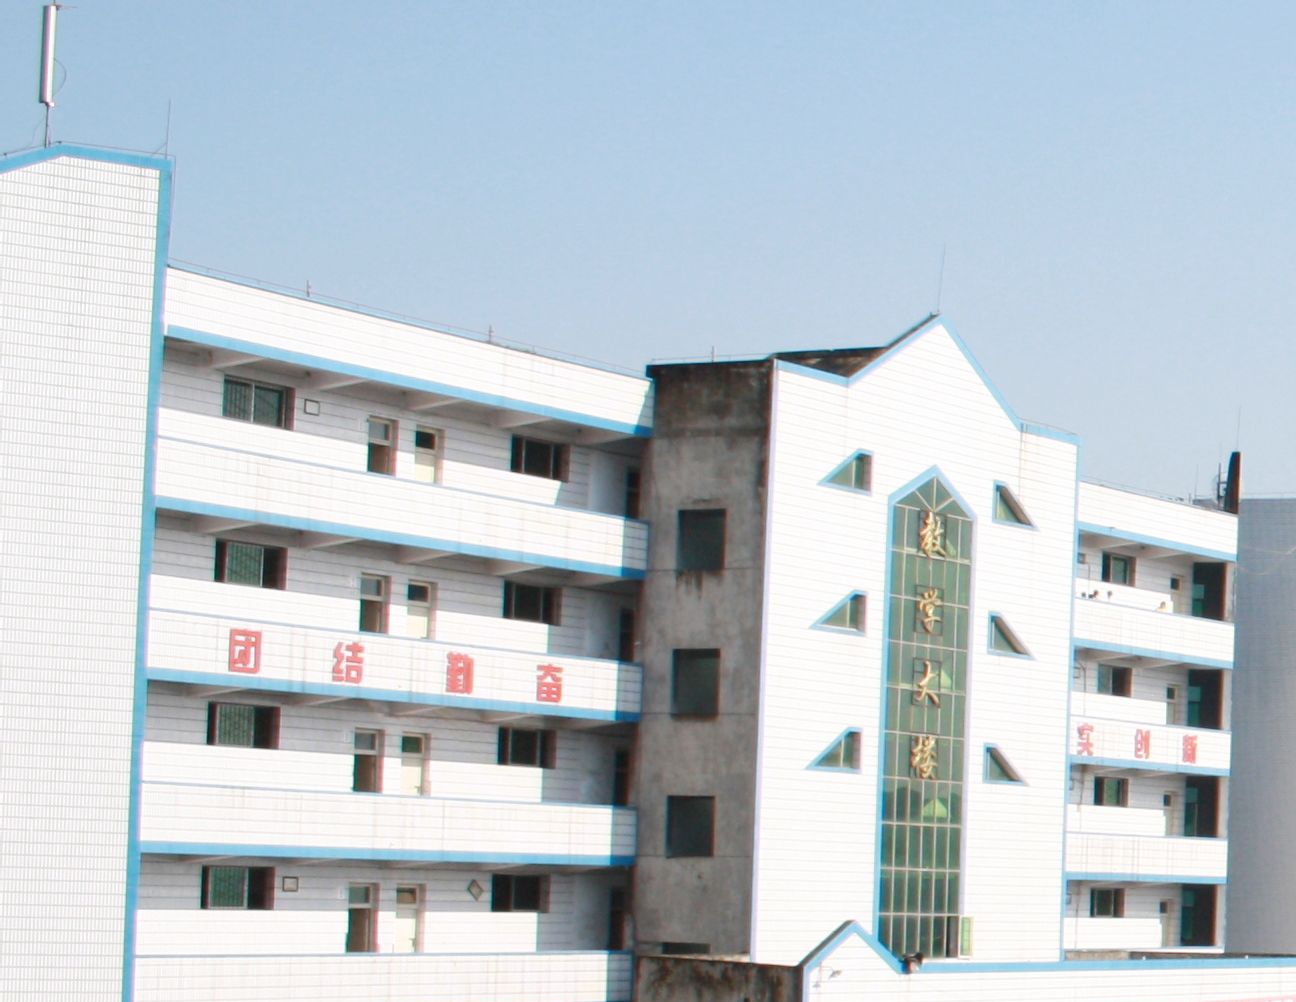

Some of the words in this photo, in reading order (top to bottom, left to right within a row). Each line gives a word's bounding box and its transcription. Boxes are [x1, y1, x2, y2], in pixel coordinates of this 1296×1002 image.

[229, 628, 563, 702] 团结勤奋
[911, 511, 946, 779] 教学大楼
